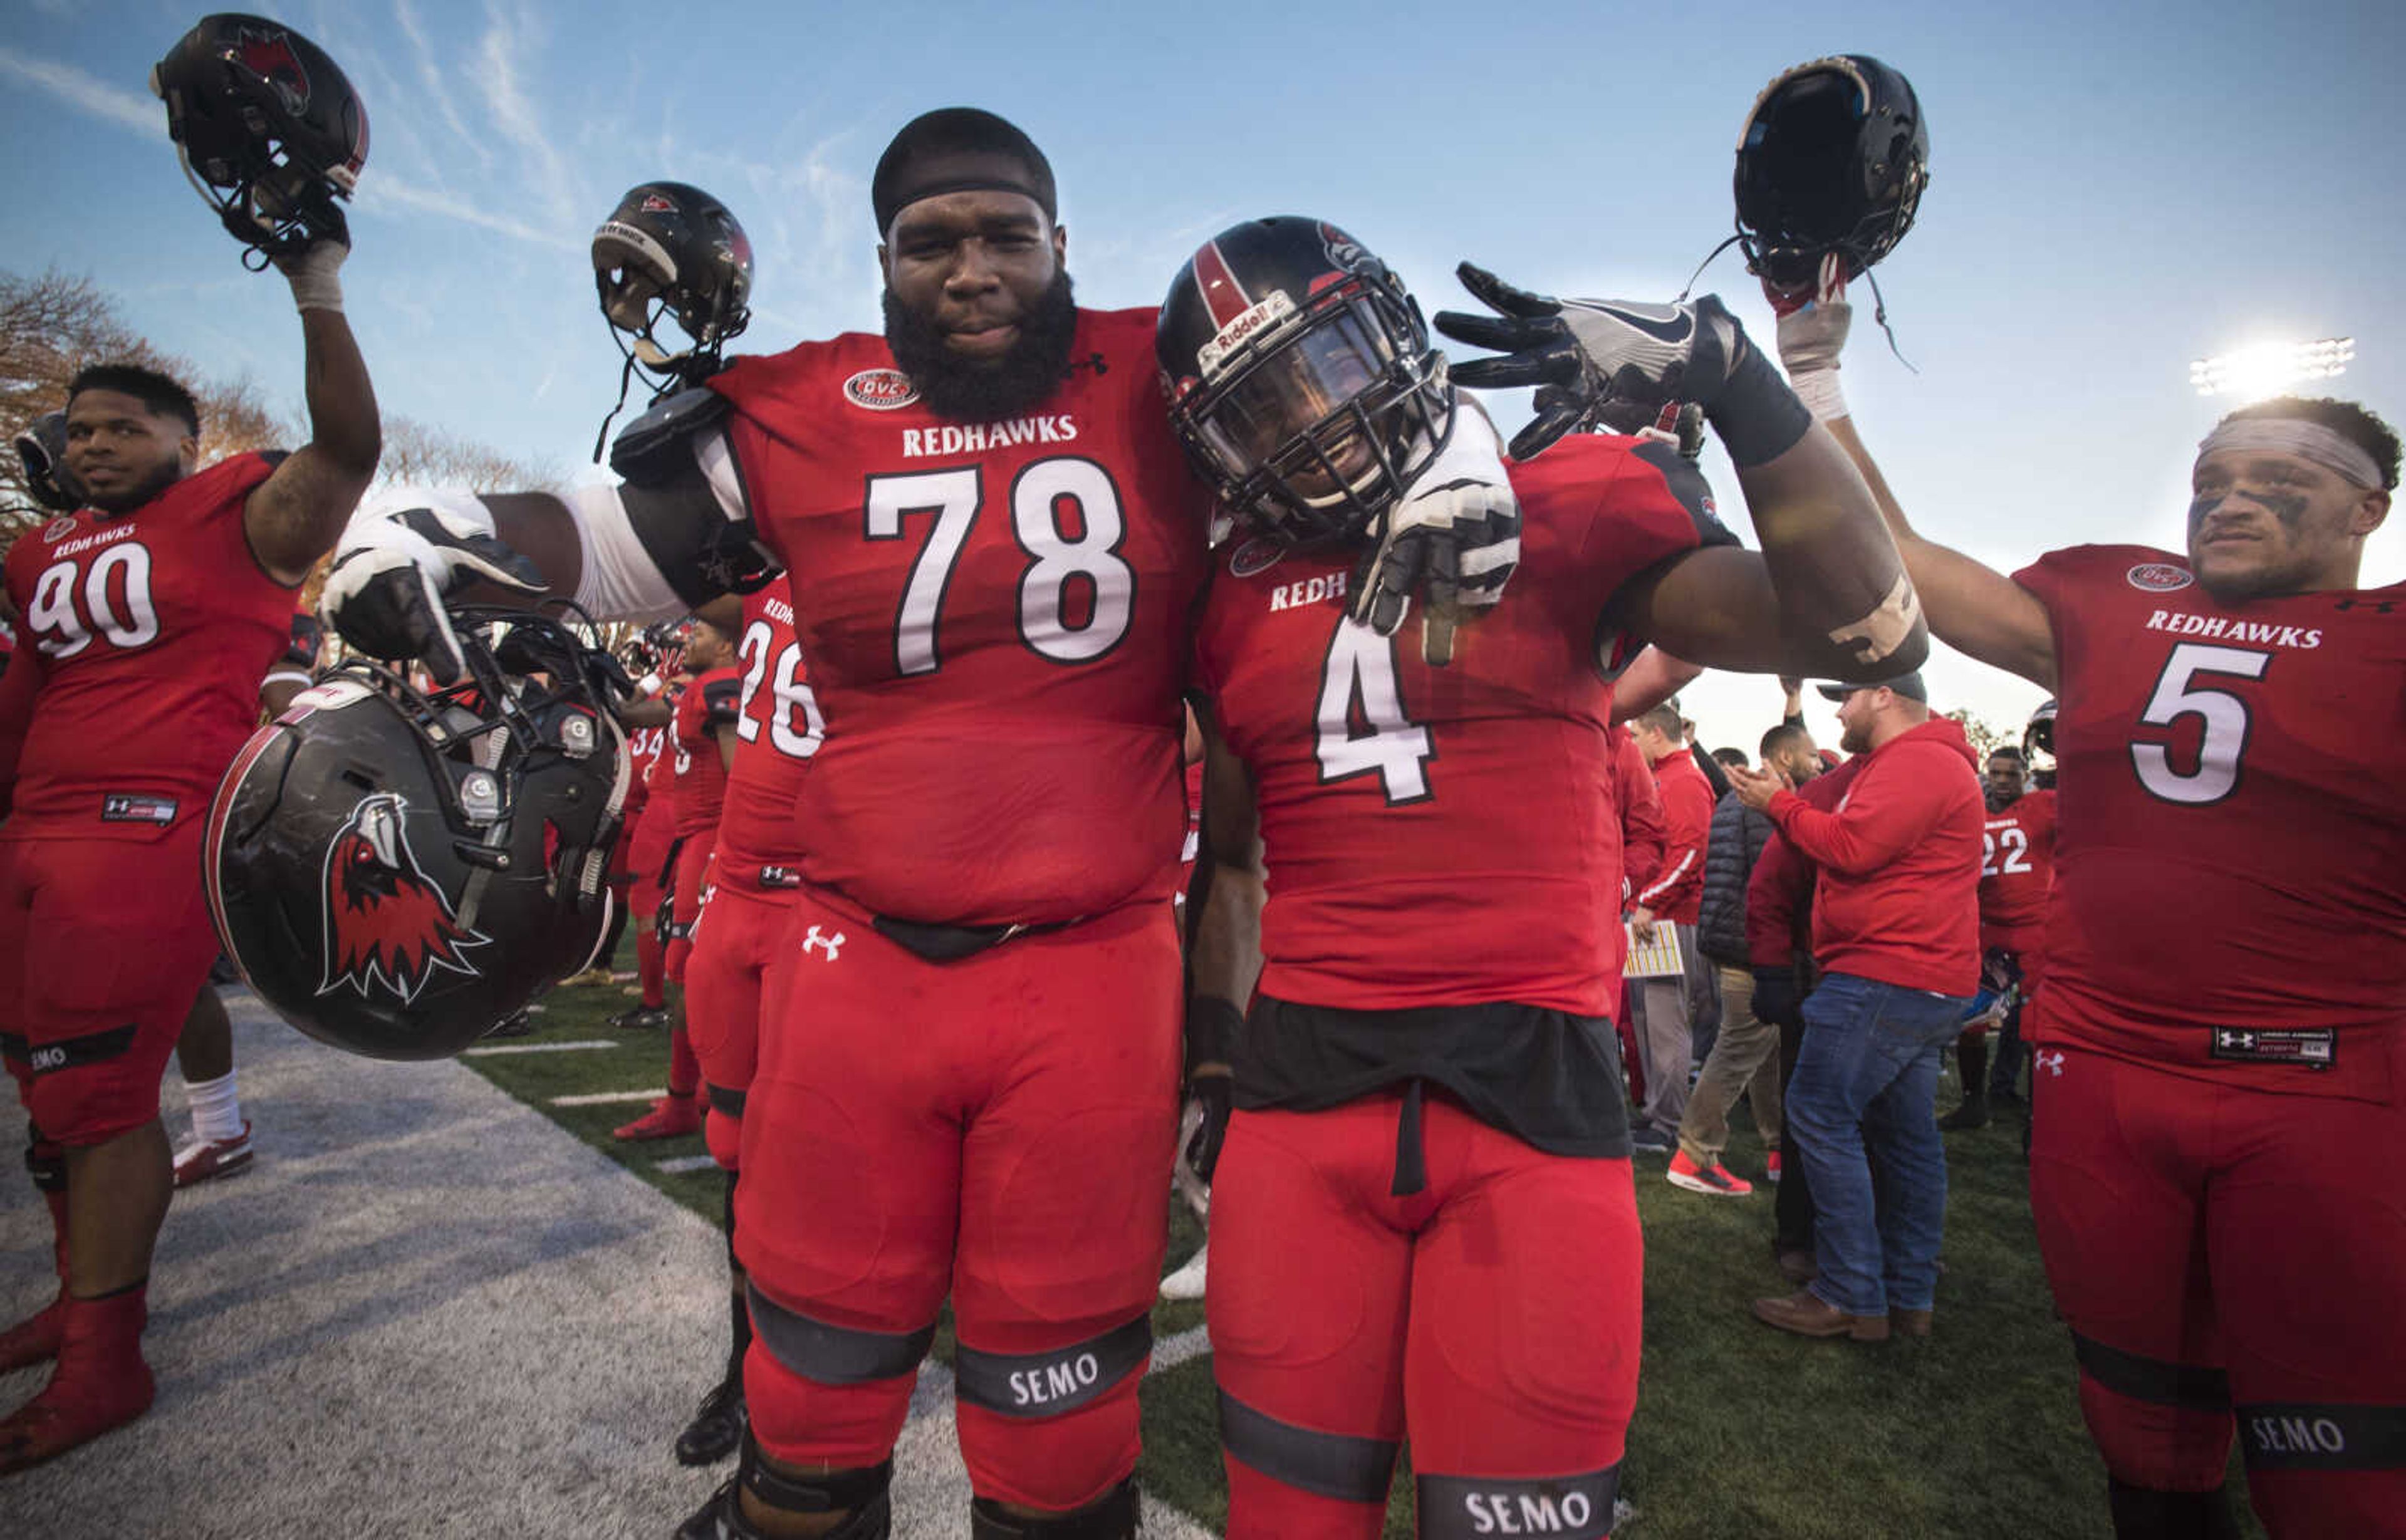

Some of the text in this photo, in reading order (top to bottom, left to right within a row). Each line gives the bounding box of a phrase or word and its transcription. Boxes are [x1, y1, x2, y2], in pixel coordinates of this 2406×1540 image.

[1218, 304, 1270, 351] Riddell
[902, 415, 1078, 457] REDHAWKS
[53, 523, 136, 559] REDHAWKS
[863, 455, 1138, 679] 78
[28, 541, 160, 659] 90
[2145, 610, 2323, 648] REDHAWKS
[737, 618, 826, 760] 26
[1312, 611, 1437, 808] 4
[2128, 640, 2274, 807] 5
[1982, 827, 2033, 876] 22
[1010, 1353, 1098, 1405] SEMO
[2252, 1417, 2344, 1453] SEMO
[1465, 1489, 1591, 1534] SEMO
